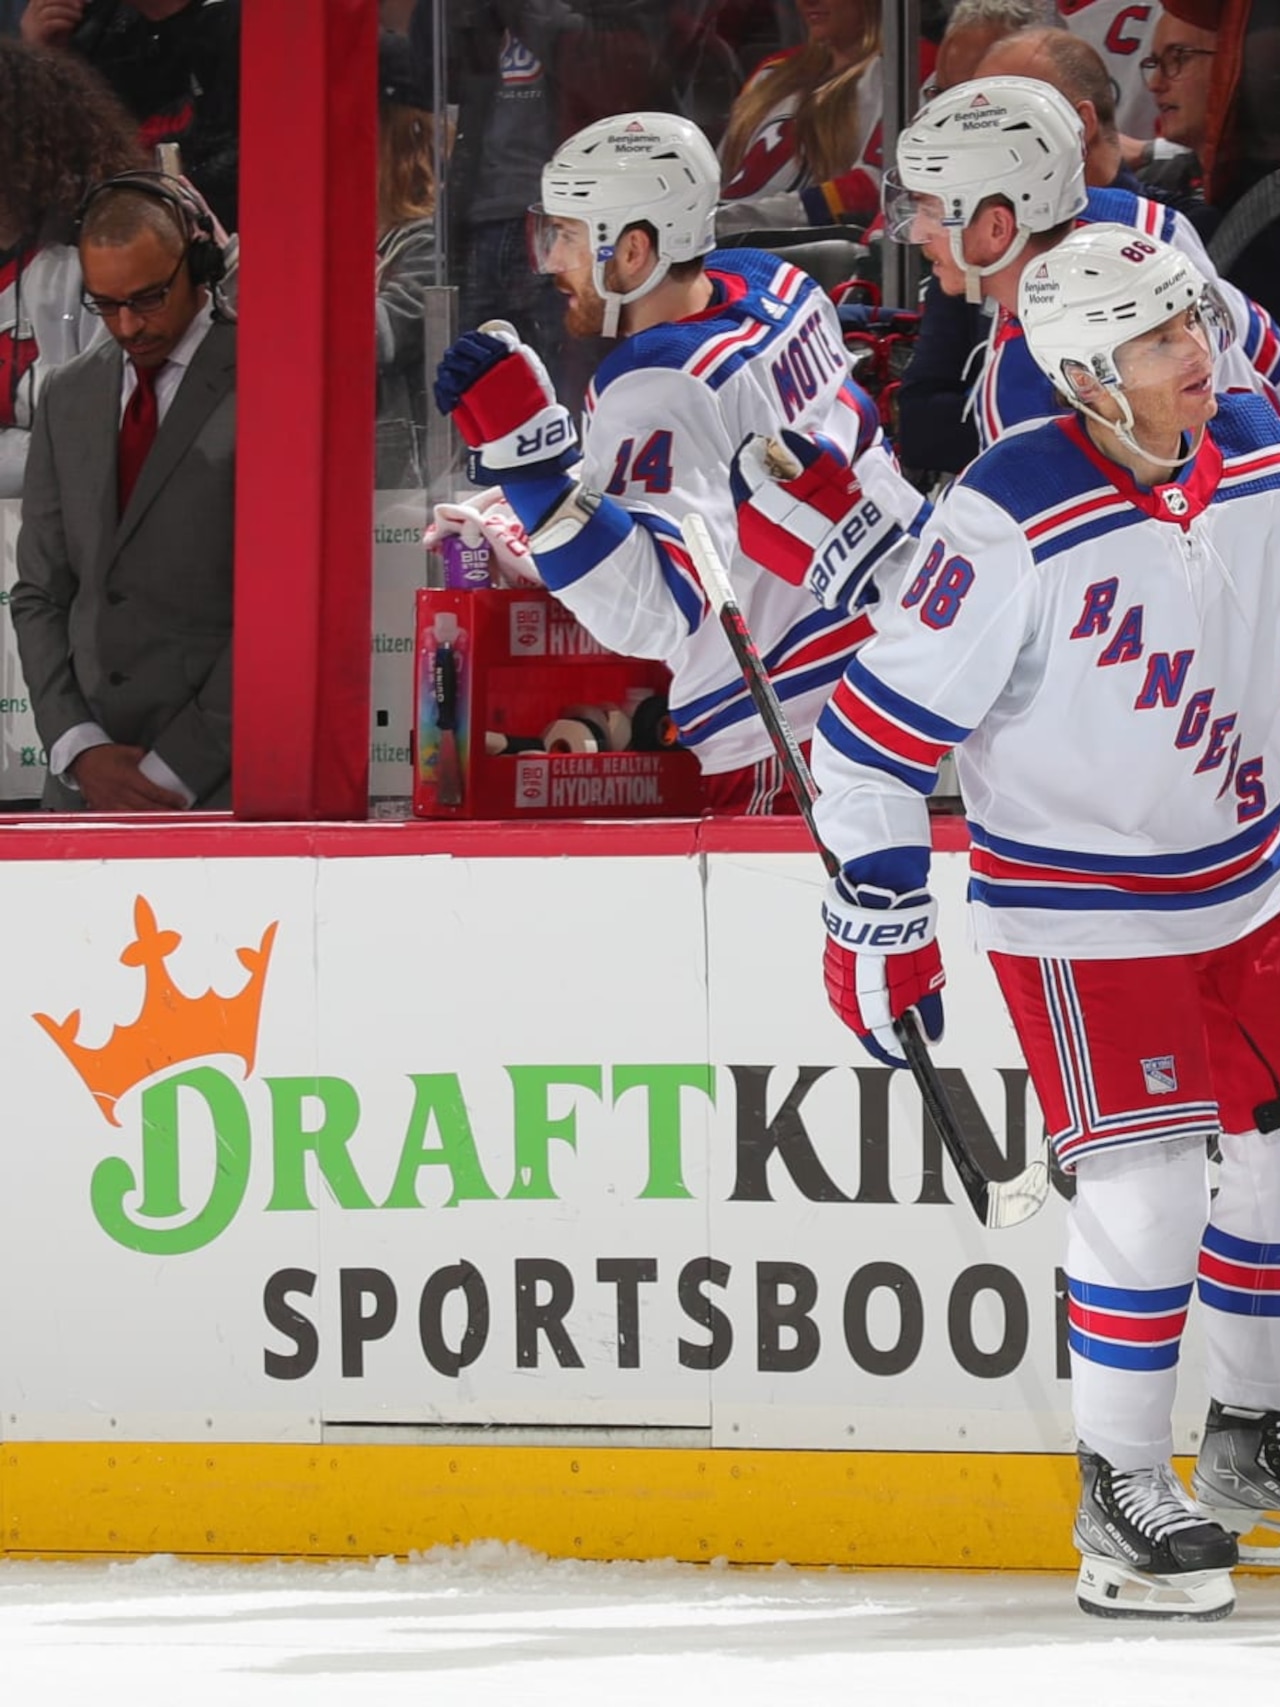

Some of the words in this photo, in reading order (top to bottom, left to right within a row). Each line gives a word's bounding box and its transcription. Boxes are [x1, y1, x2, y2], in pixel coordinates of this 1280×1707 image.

[1104, 5, 1152, 56] C
[954, 107, 1007, 122] Benjamin
[962, 118, 999, 131] Moore
[607, 135, 660, 144] Benjamin
[615, 144, 653, 153] Moore
[1024, 281, 1060, 294] Benjamin
[1029, 294, 1055, 304] Moore
[771, 309, 844, 424] MOTTE
[605, 429, 673, 497] 14
[461, 550, 489, 563] BIO
[900, 538, 976, 631] 88
[90, 1063, 1076, 1256] DRAFTKIN
